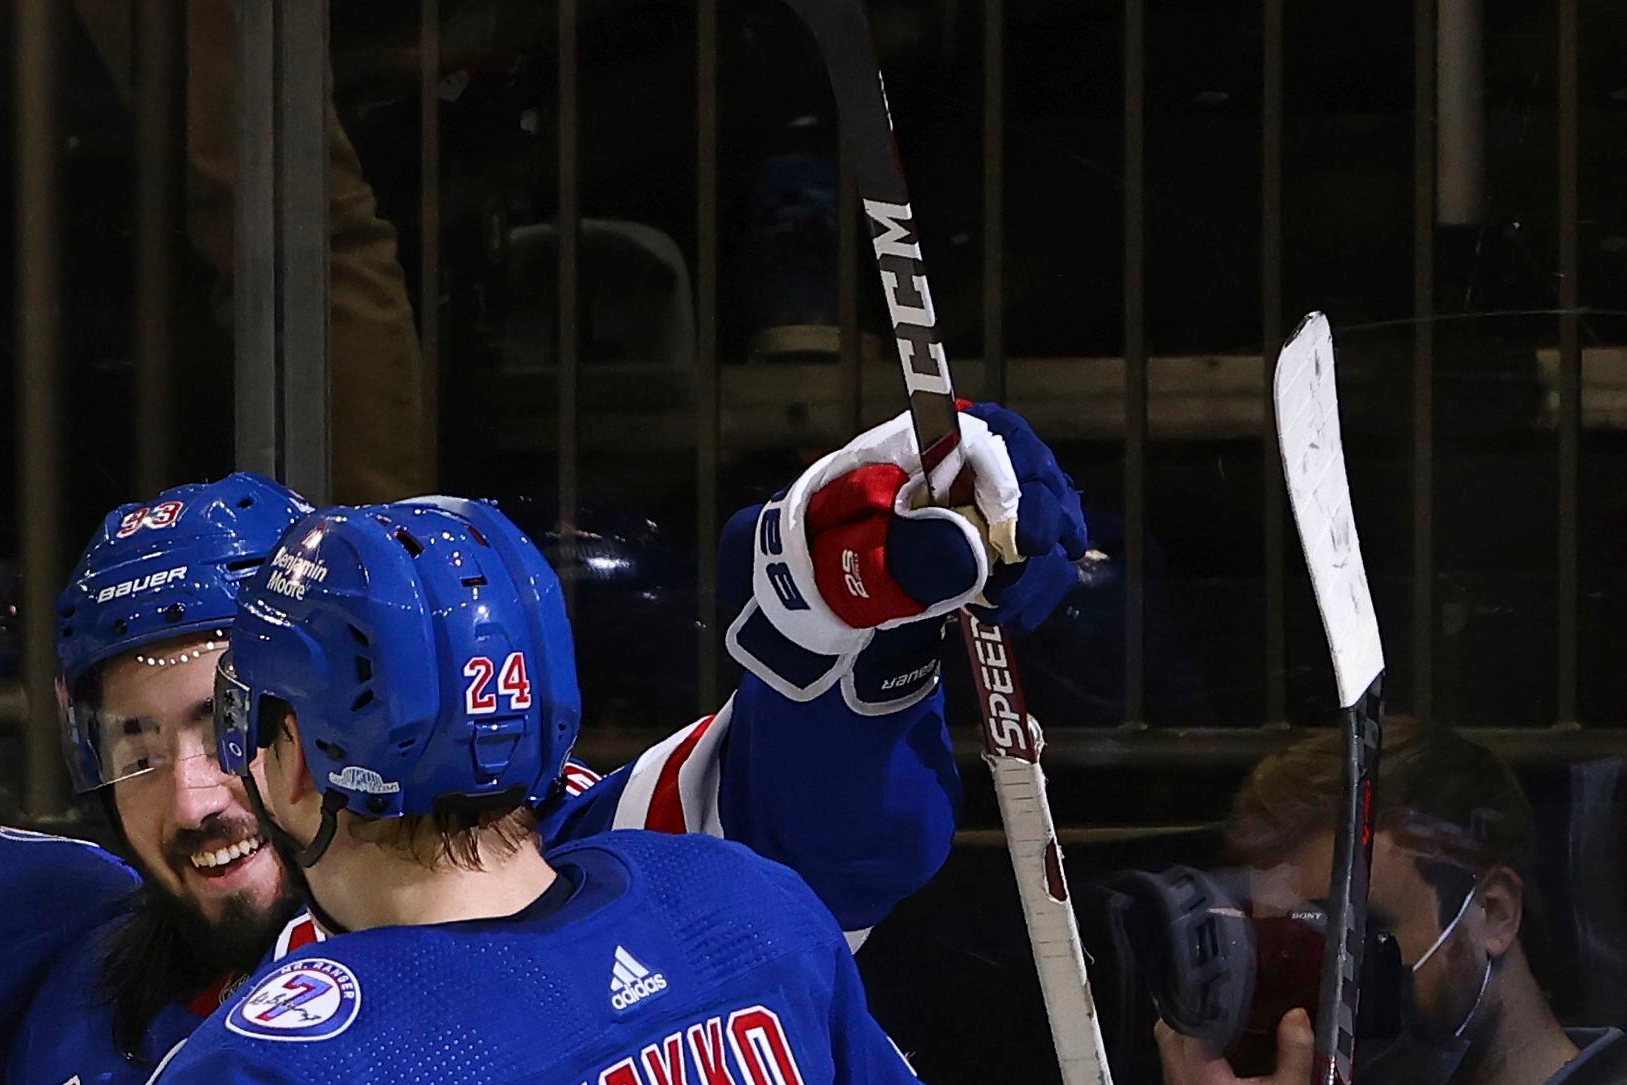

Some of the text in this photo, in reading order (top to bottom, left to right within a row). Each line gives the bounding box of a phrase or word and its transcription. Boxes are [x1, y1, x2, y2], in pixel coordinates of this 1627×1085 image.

[864, 198, 953, 397] CCM
[116, 501, 184, 538] 93
[271, 545, 328, 582] Benjamin
[97, 566, 188, 604] BAUER
[266, 570, 306, 600] Moore
[463, 652, 531, 714] 24
[254, 973, 333, 1022] 7
[280, 960, 356, 999] MR. RANGER
[611, 973, 668, 1010] adidas
